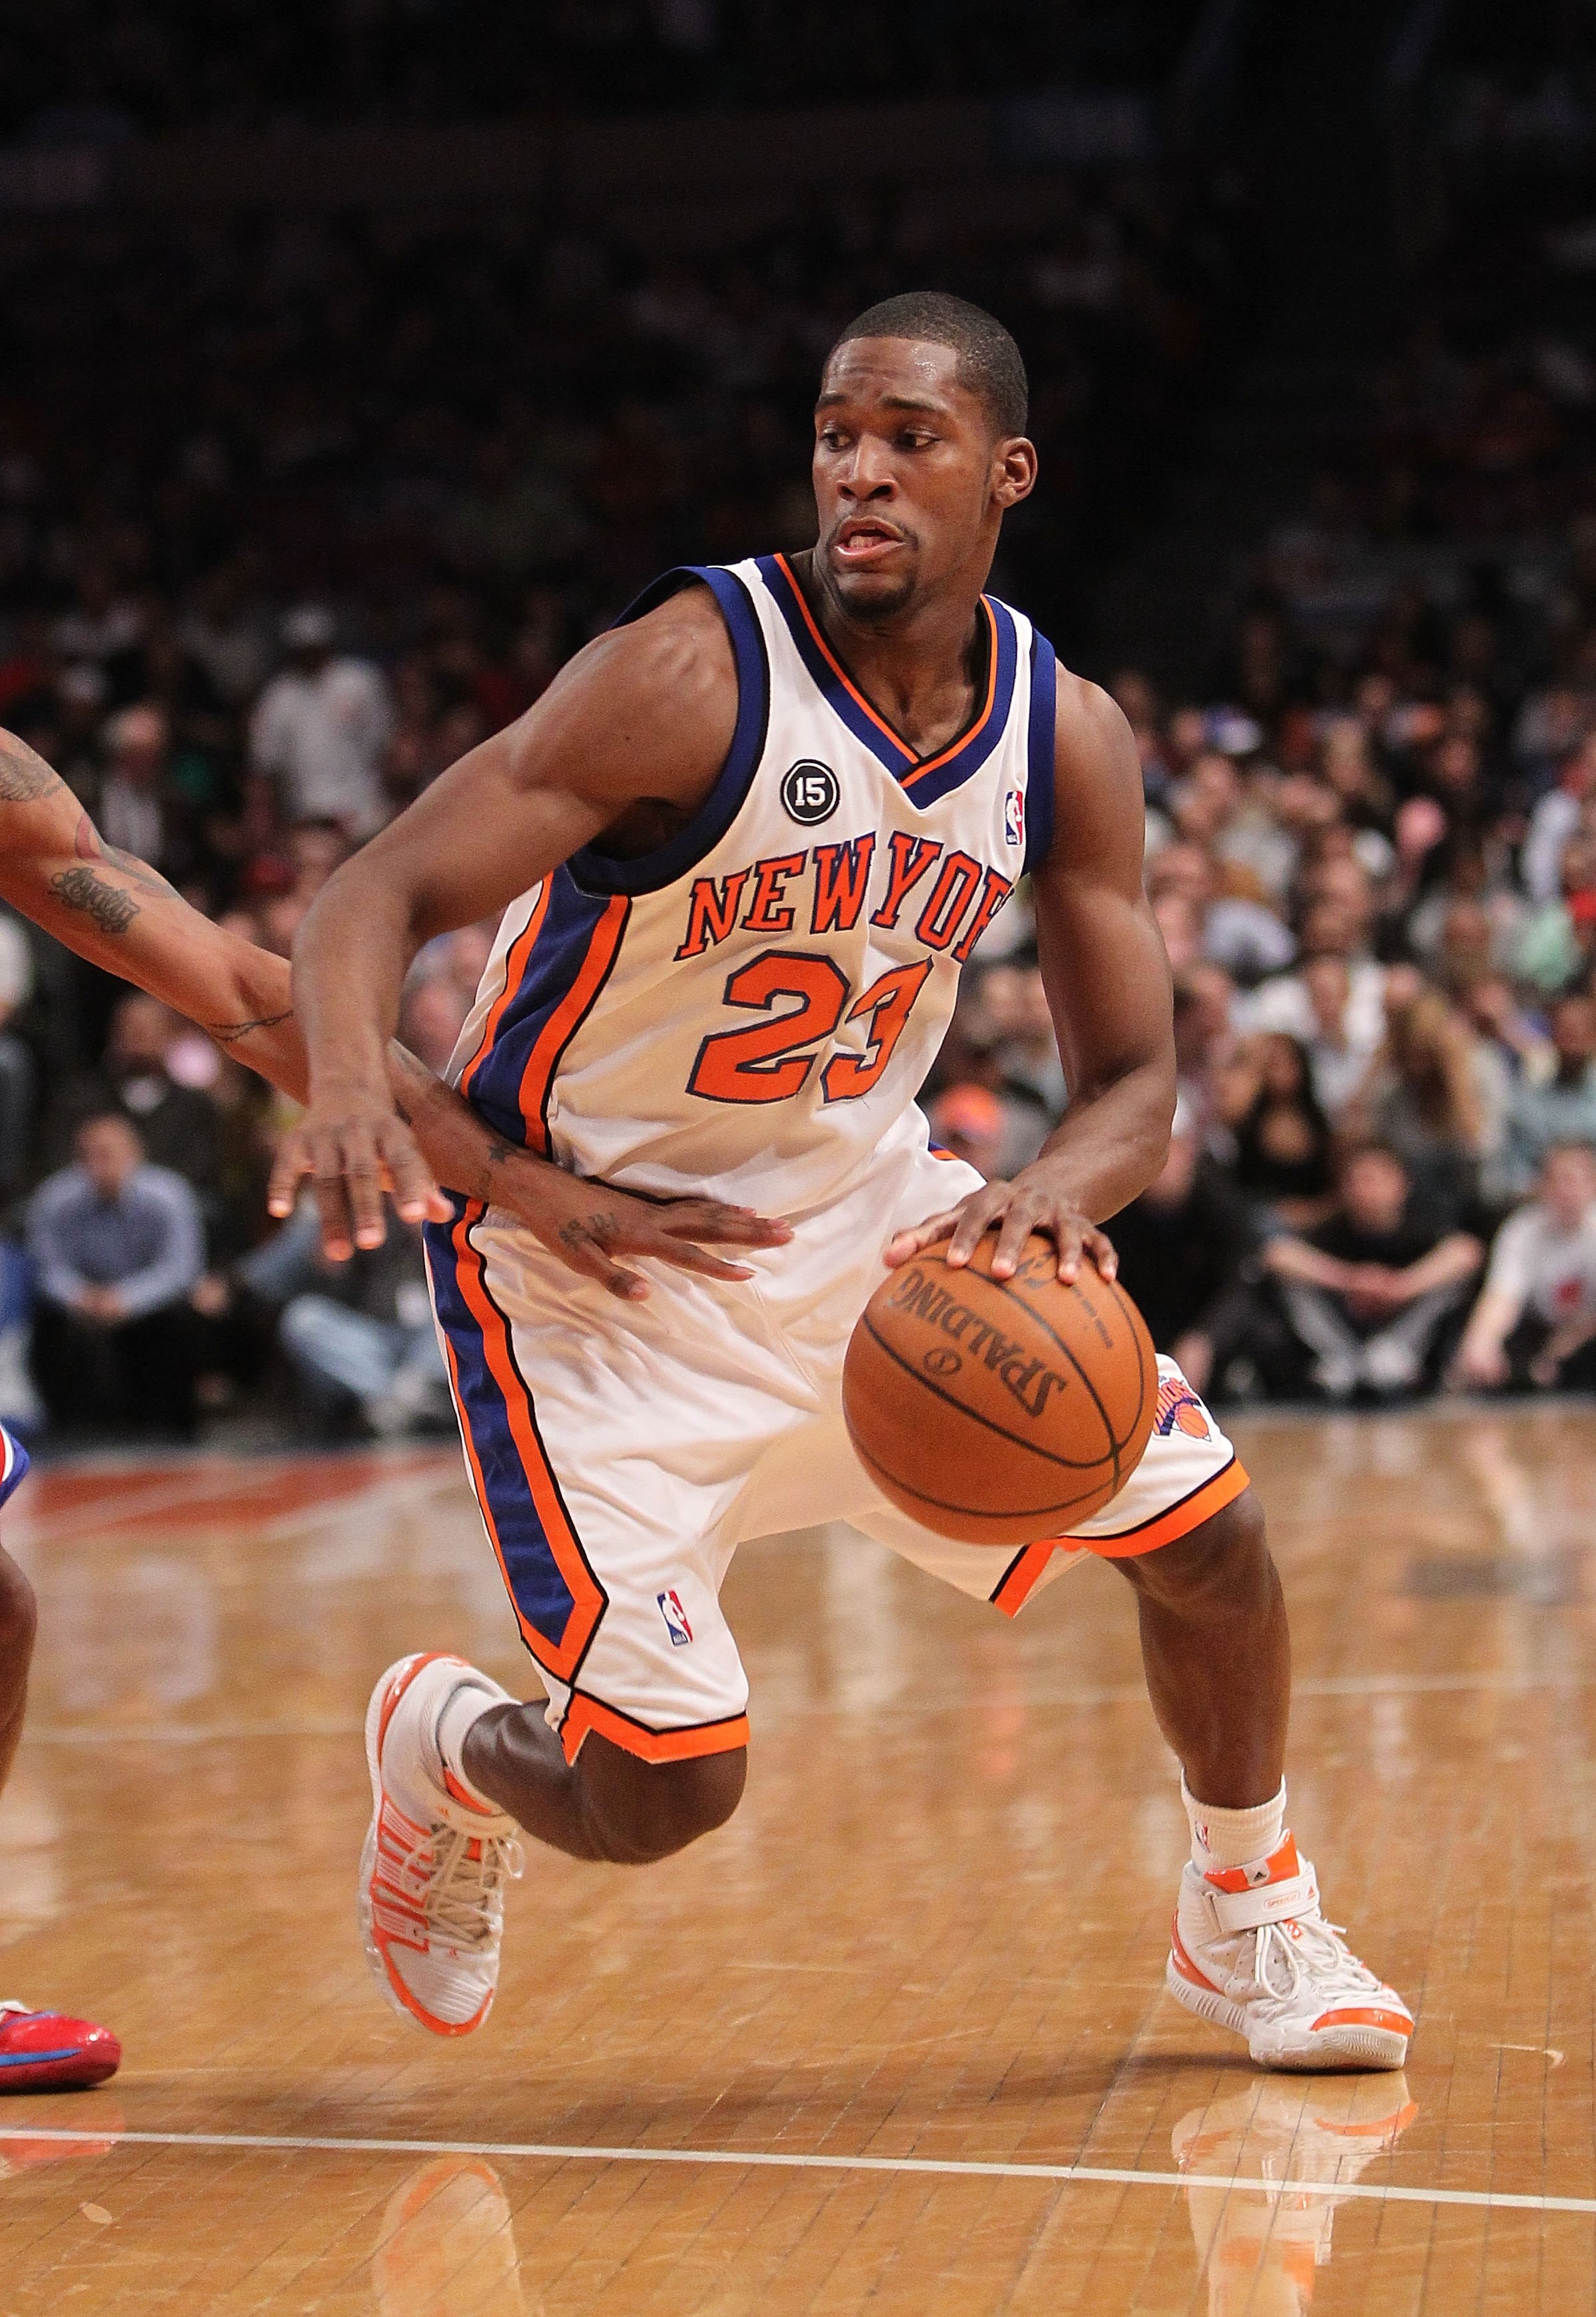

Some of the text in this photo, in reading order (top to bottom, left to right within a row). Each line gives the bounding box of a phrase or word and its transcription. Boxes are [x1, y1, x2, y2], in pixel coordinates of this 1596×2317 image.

[795, 777, 826, 807] 15
[674, 832, 875, 961] NEW
[685, 949, 933, 1104] 23
[889, 1269, 1067, 1417] SPALDING
